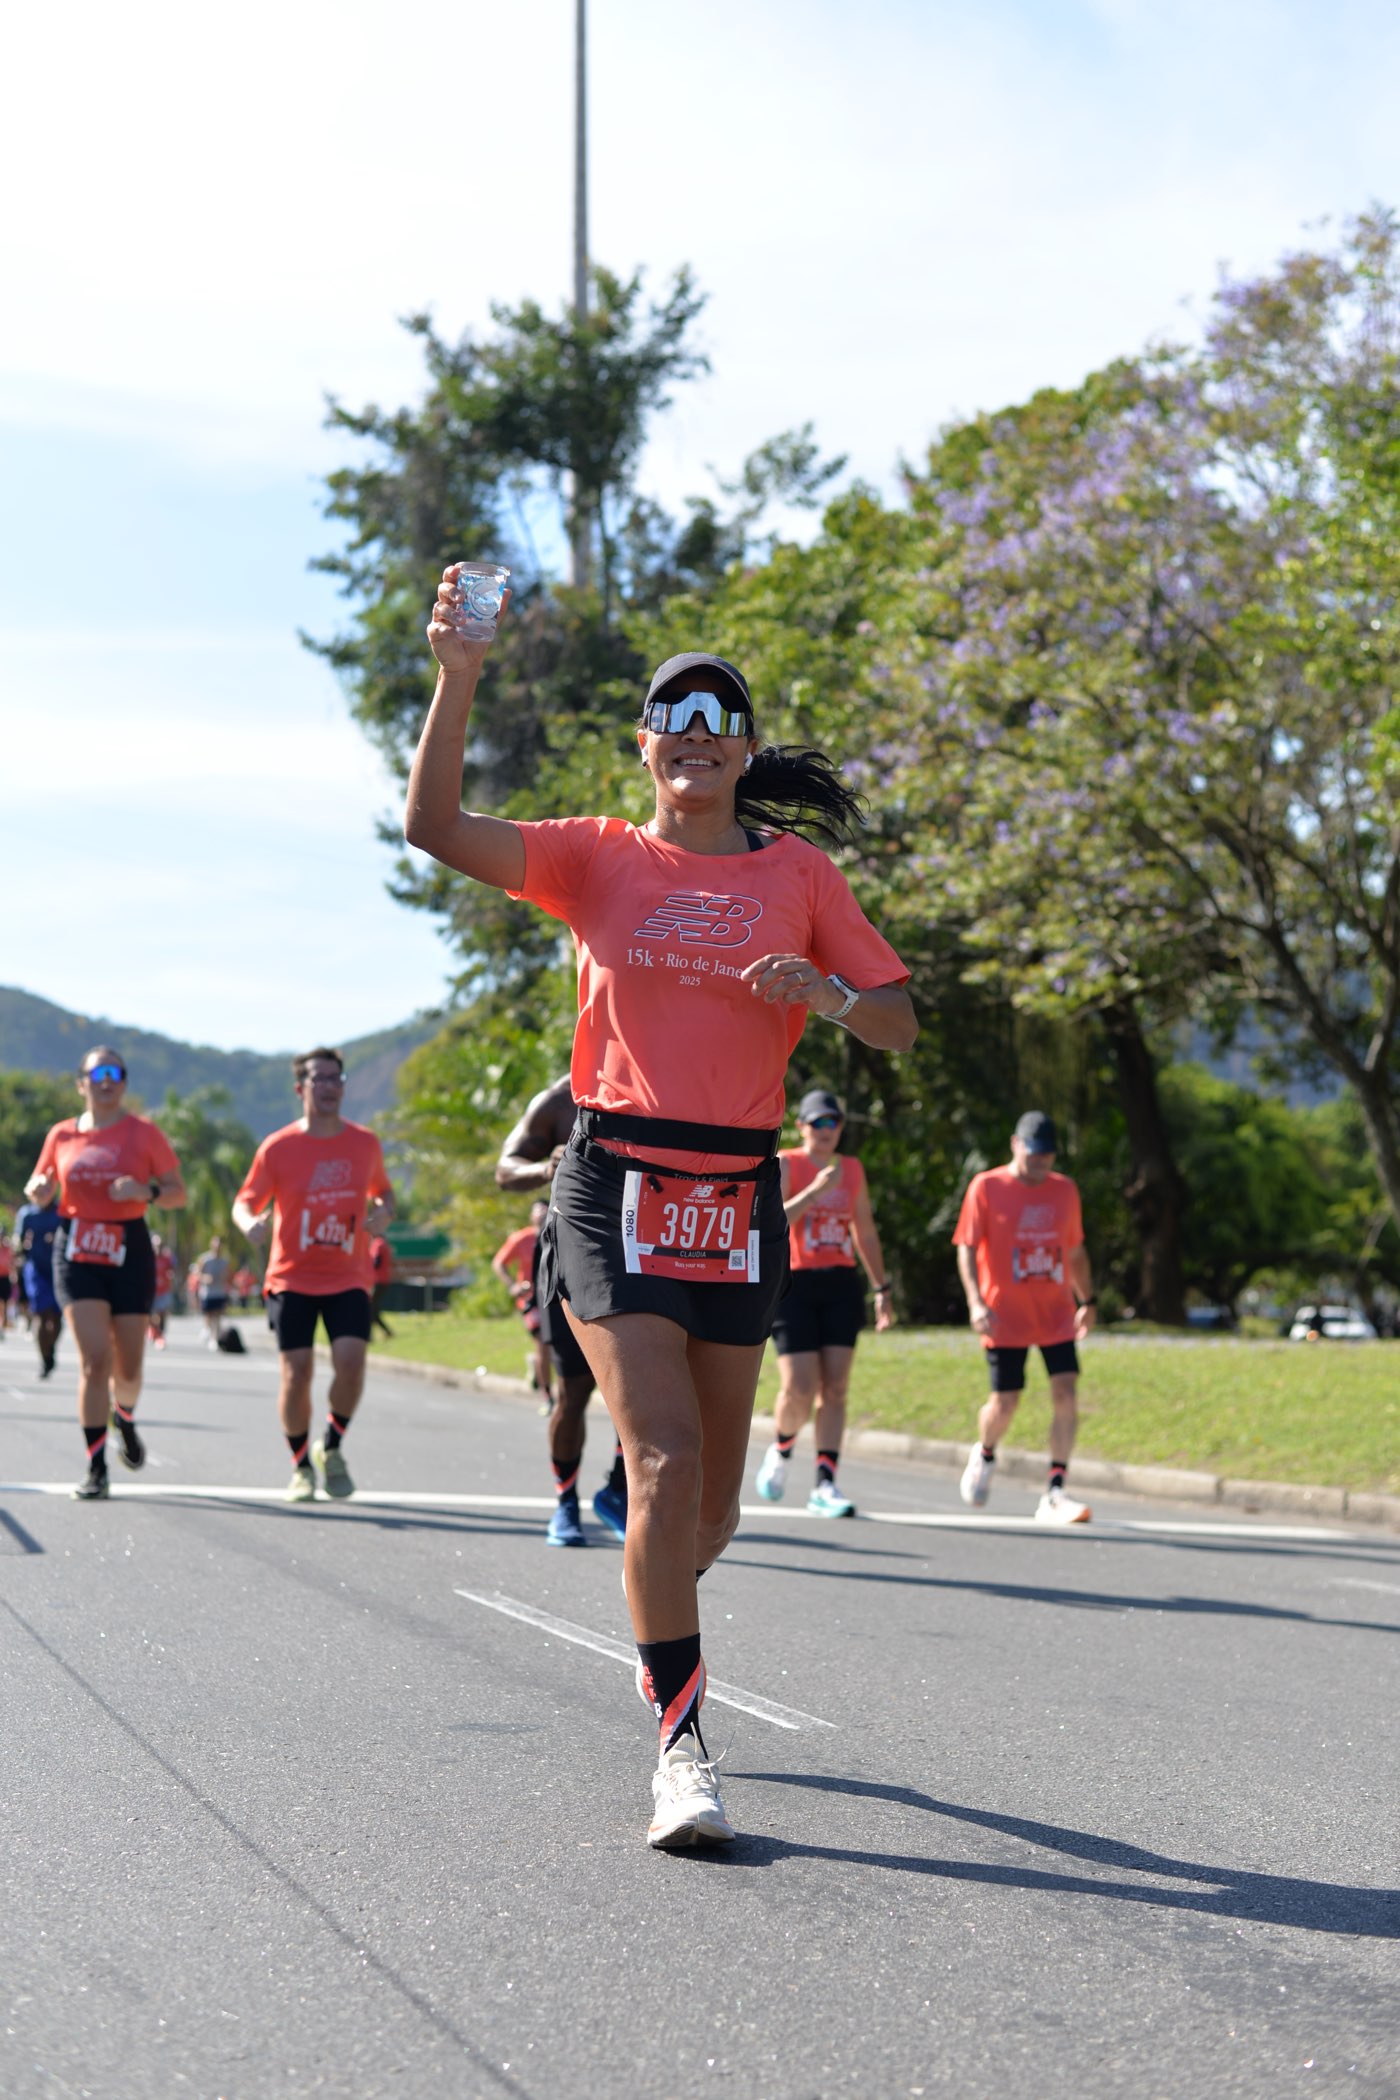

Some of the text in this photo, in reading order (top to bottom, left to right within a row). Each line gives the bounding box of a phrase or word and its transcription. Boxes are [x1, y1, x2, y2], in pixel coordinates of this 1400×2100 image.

[626, 948, 743, 979] 15k Rio de Jane
[679, 975, 701, 987] 2025
[626, 1209, 635, 1238] 1080
[660, 1203, 735, 1249] 3979
[679, 1250, 707, 1258] CLAUDIA
